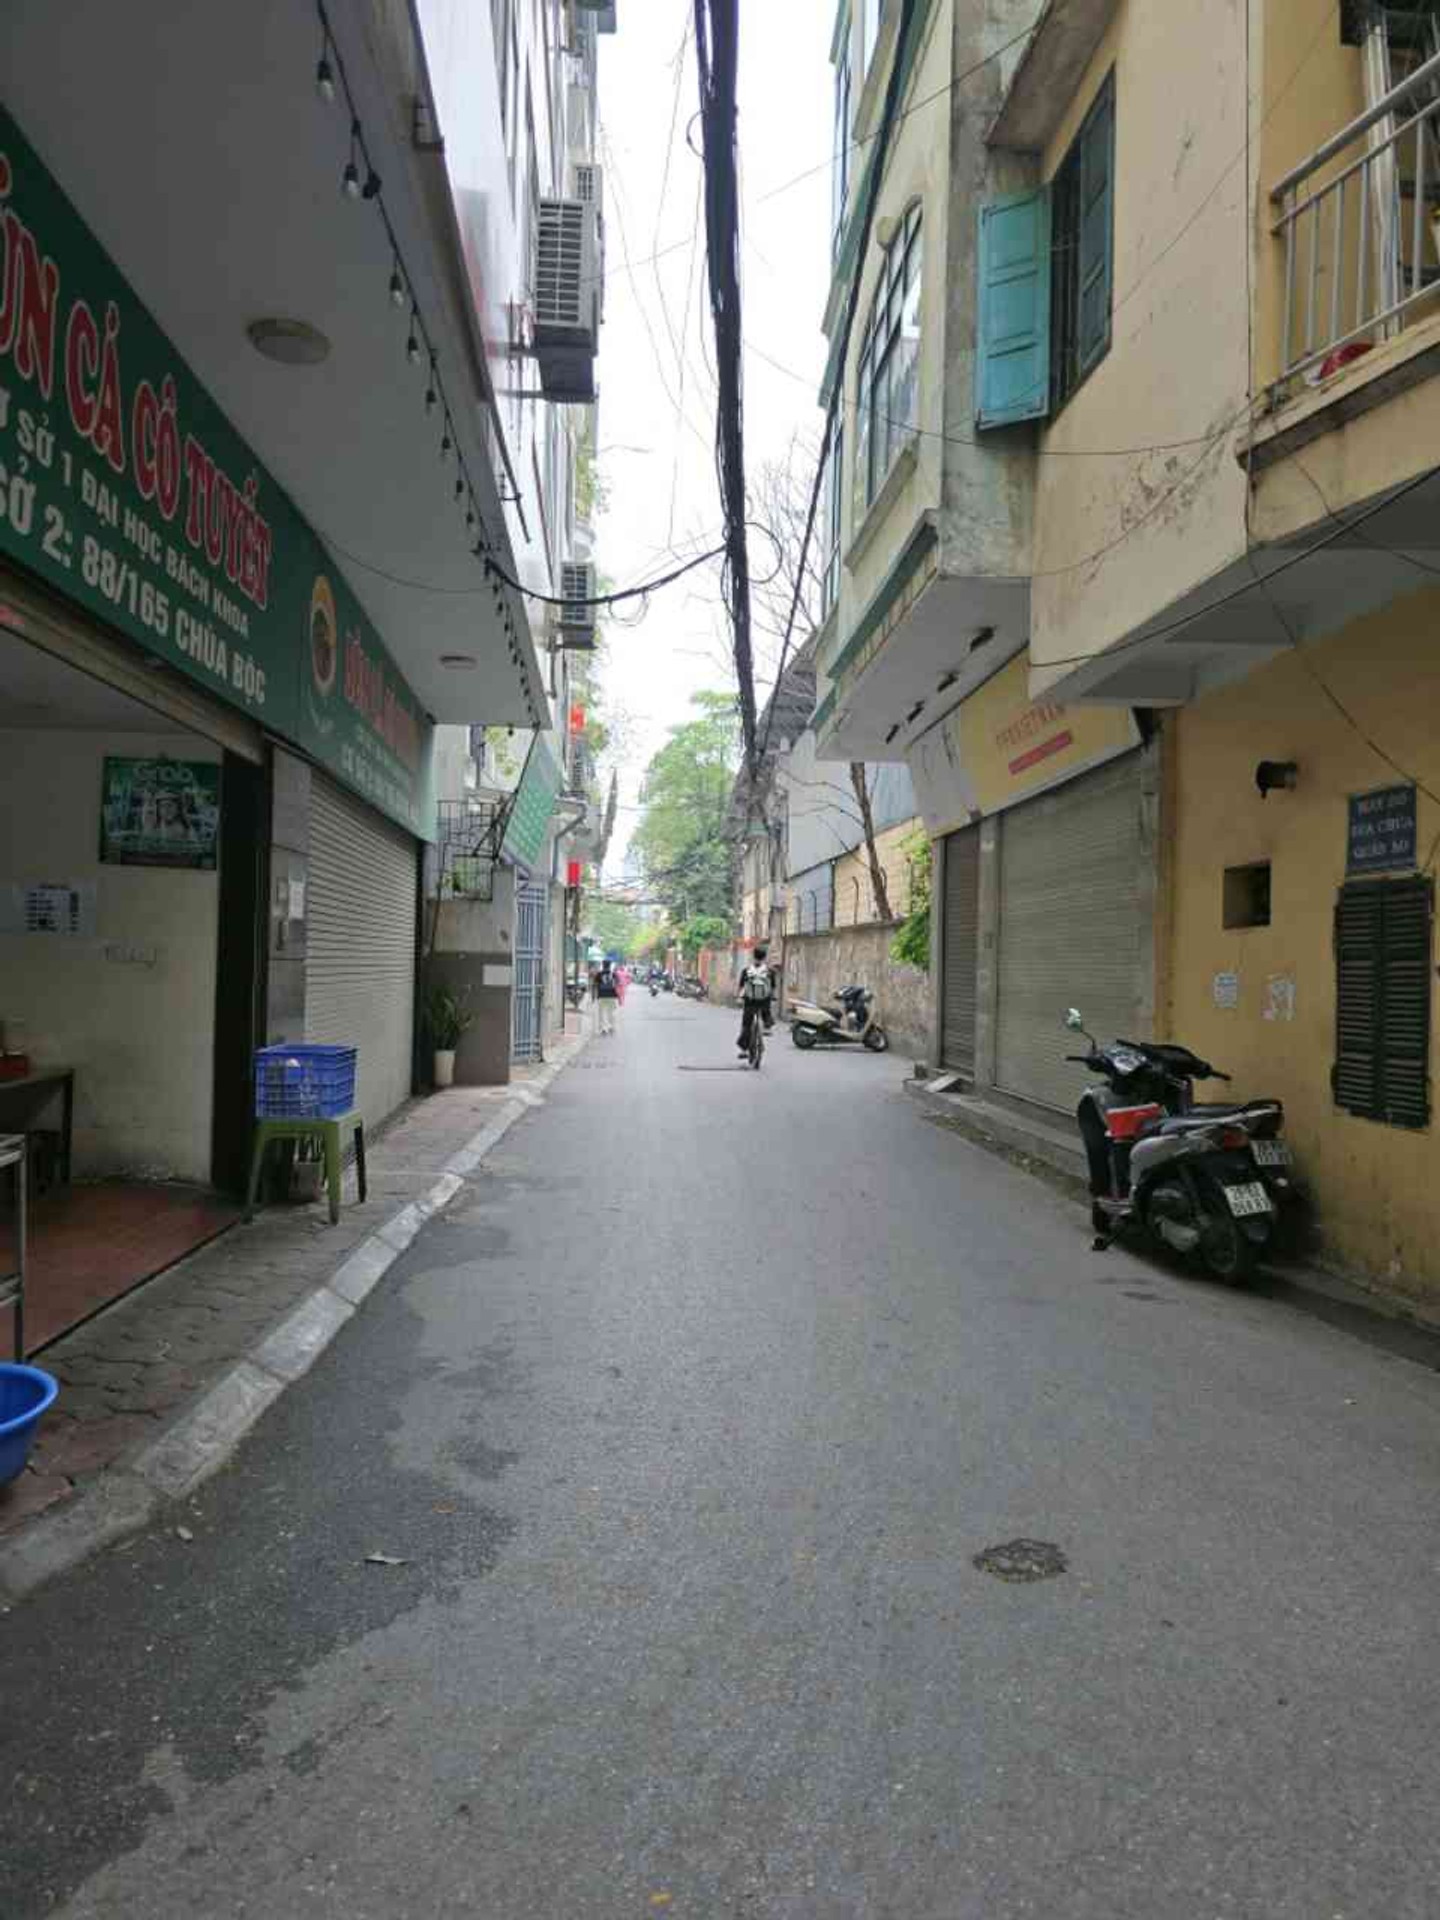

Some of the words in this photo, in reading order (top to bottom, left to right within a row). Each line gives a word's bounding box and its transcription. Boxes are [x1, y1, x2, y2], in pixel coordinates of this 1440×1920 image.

[16, 408, 55, 469] SỞ
[61, 449, 72, 487] 1
[81, 469, 119, 529] ĐẠI
[124, 508, 161, 565] HỌC
[166, 549, 210, 606] BÁCH
[213, 589, 250, 639] KHOA
[42, 503, 74, 568] 2:
[82, 539, 170, 638] 88/165
[175, 609, 228, 681] CHÙA
[233, 651, 267, 706] BỘC
[184, 434, 274, 611] TUYẾT
